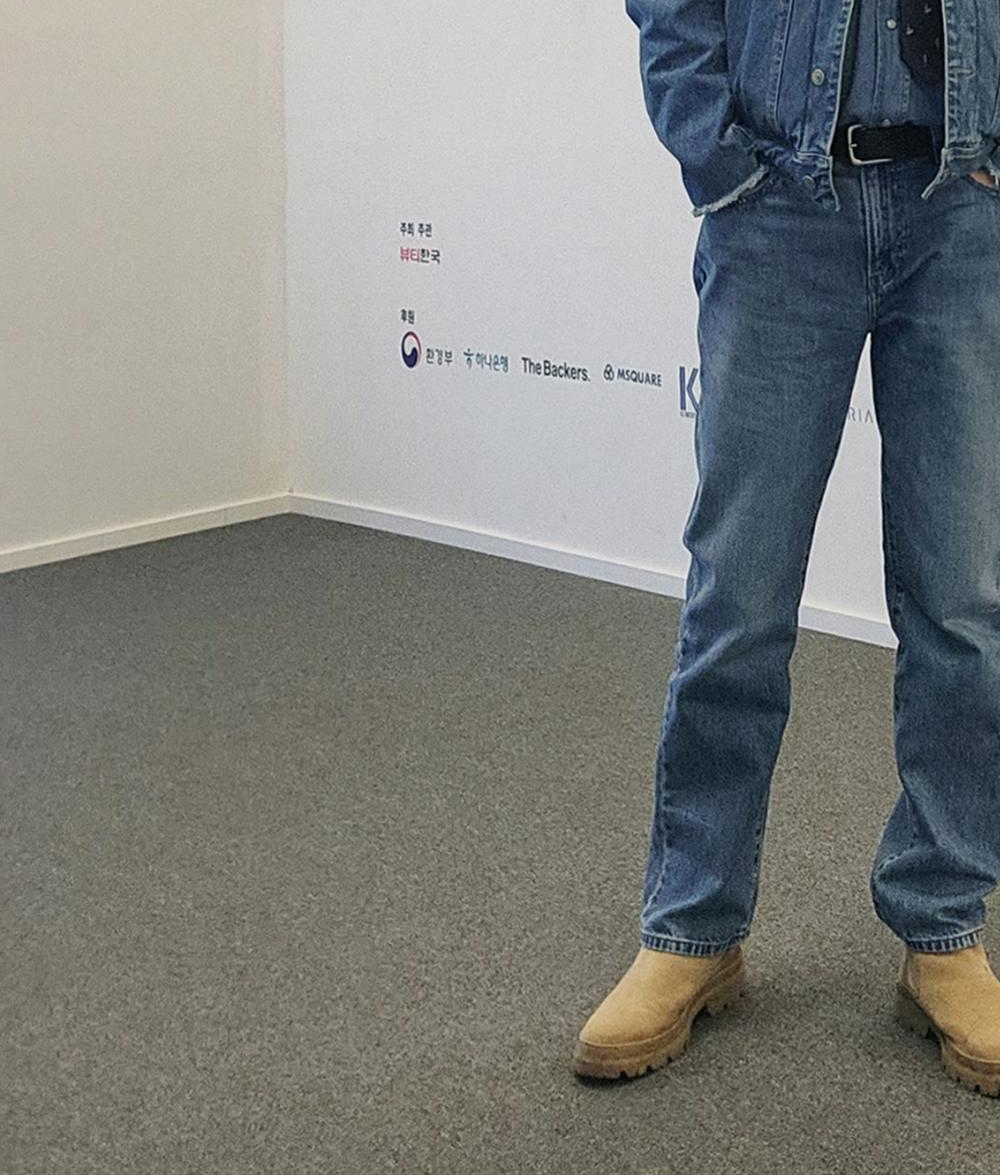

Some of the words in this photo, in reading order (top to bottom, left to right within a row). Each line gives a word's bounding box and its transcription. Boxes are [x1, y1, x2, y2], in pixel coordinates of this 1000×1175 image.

[399, 246, 441, 265] 뷰티한국
[425, 347, 453, 367] 환경부
[521, 356, 542, 376] The
[616, 367, 662, 387] MSQUARE
